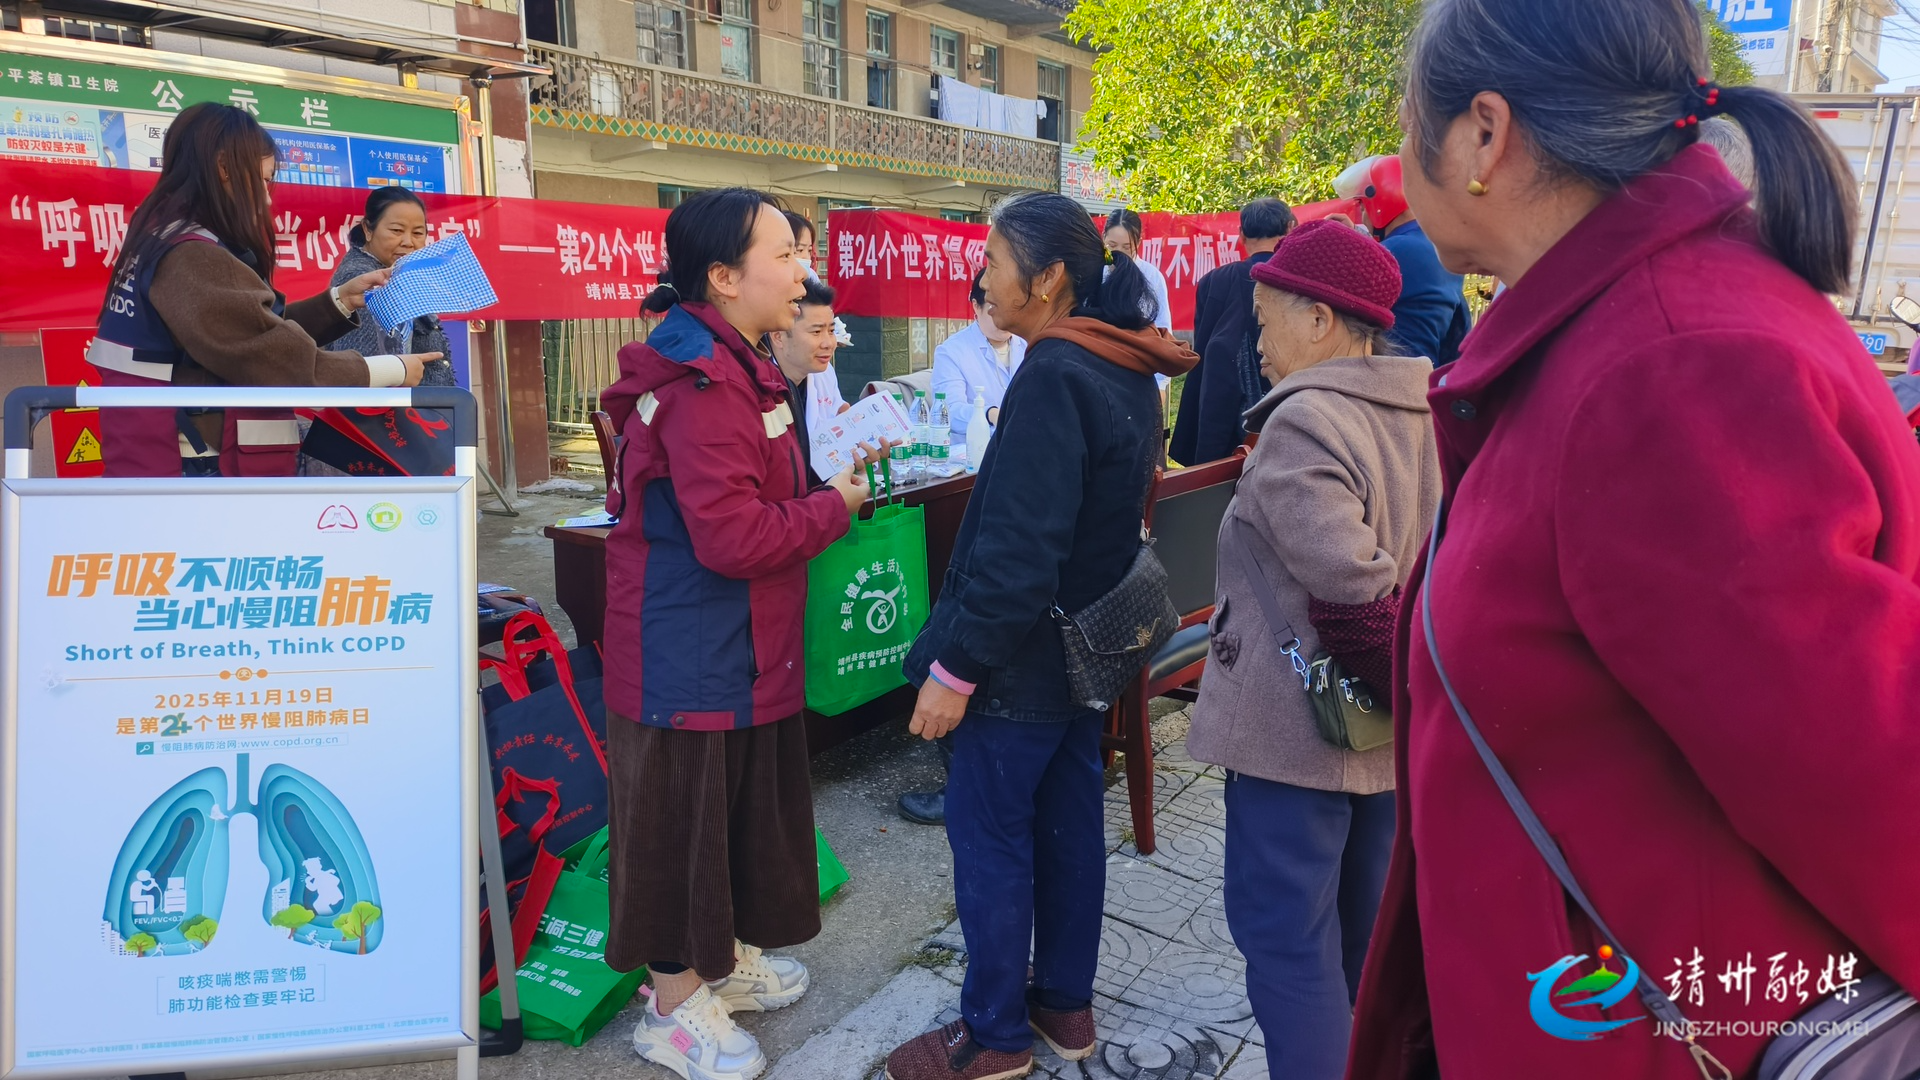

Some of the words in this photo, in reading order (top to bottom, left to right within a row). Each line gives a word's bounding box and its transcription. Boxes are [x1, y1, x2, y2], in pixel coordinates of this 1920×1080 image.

[8, 67, 120, 93] 平茶镇卫生院
[151, 79, 332, 127] 公示栏
[7, 138, 87, 155] 防蚊灭蚊是关键
[273, 137, 337, 152] 药机构使用医保基金
[368, 150, 429, 164] 个人使用医保基金
[10, 194, 138, 268] “呼吸
[47, 552, 325, 597] 呼吸不顺畅
[133, 575, 434, 632] 当心慢阻肺病
[65, 644, 134, 661] Short
[140, 642, 165, 659] of
[172, 639, 261, 660] Breath,
[268, 636, 335, 655] Think
[341, 636, 406, 653] COPD
[154, 687, 333, 709] 2025年11月19日
[116, 708, 369, 737] 是第24个世界慢阻肺病日
[178, 966, 307, 991] 咳痰喘憋需警惕
[168, 988, 316, 1014] 肺功能检查要牢记
